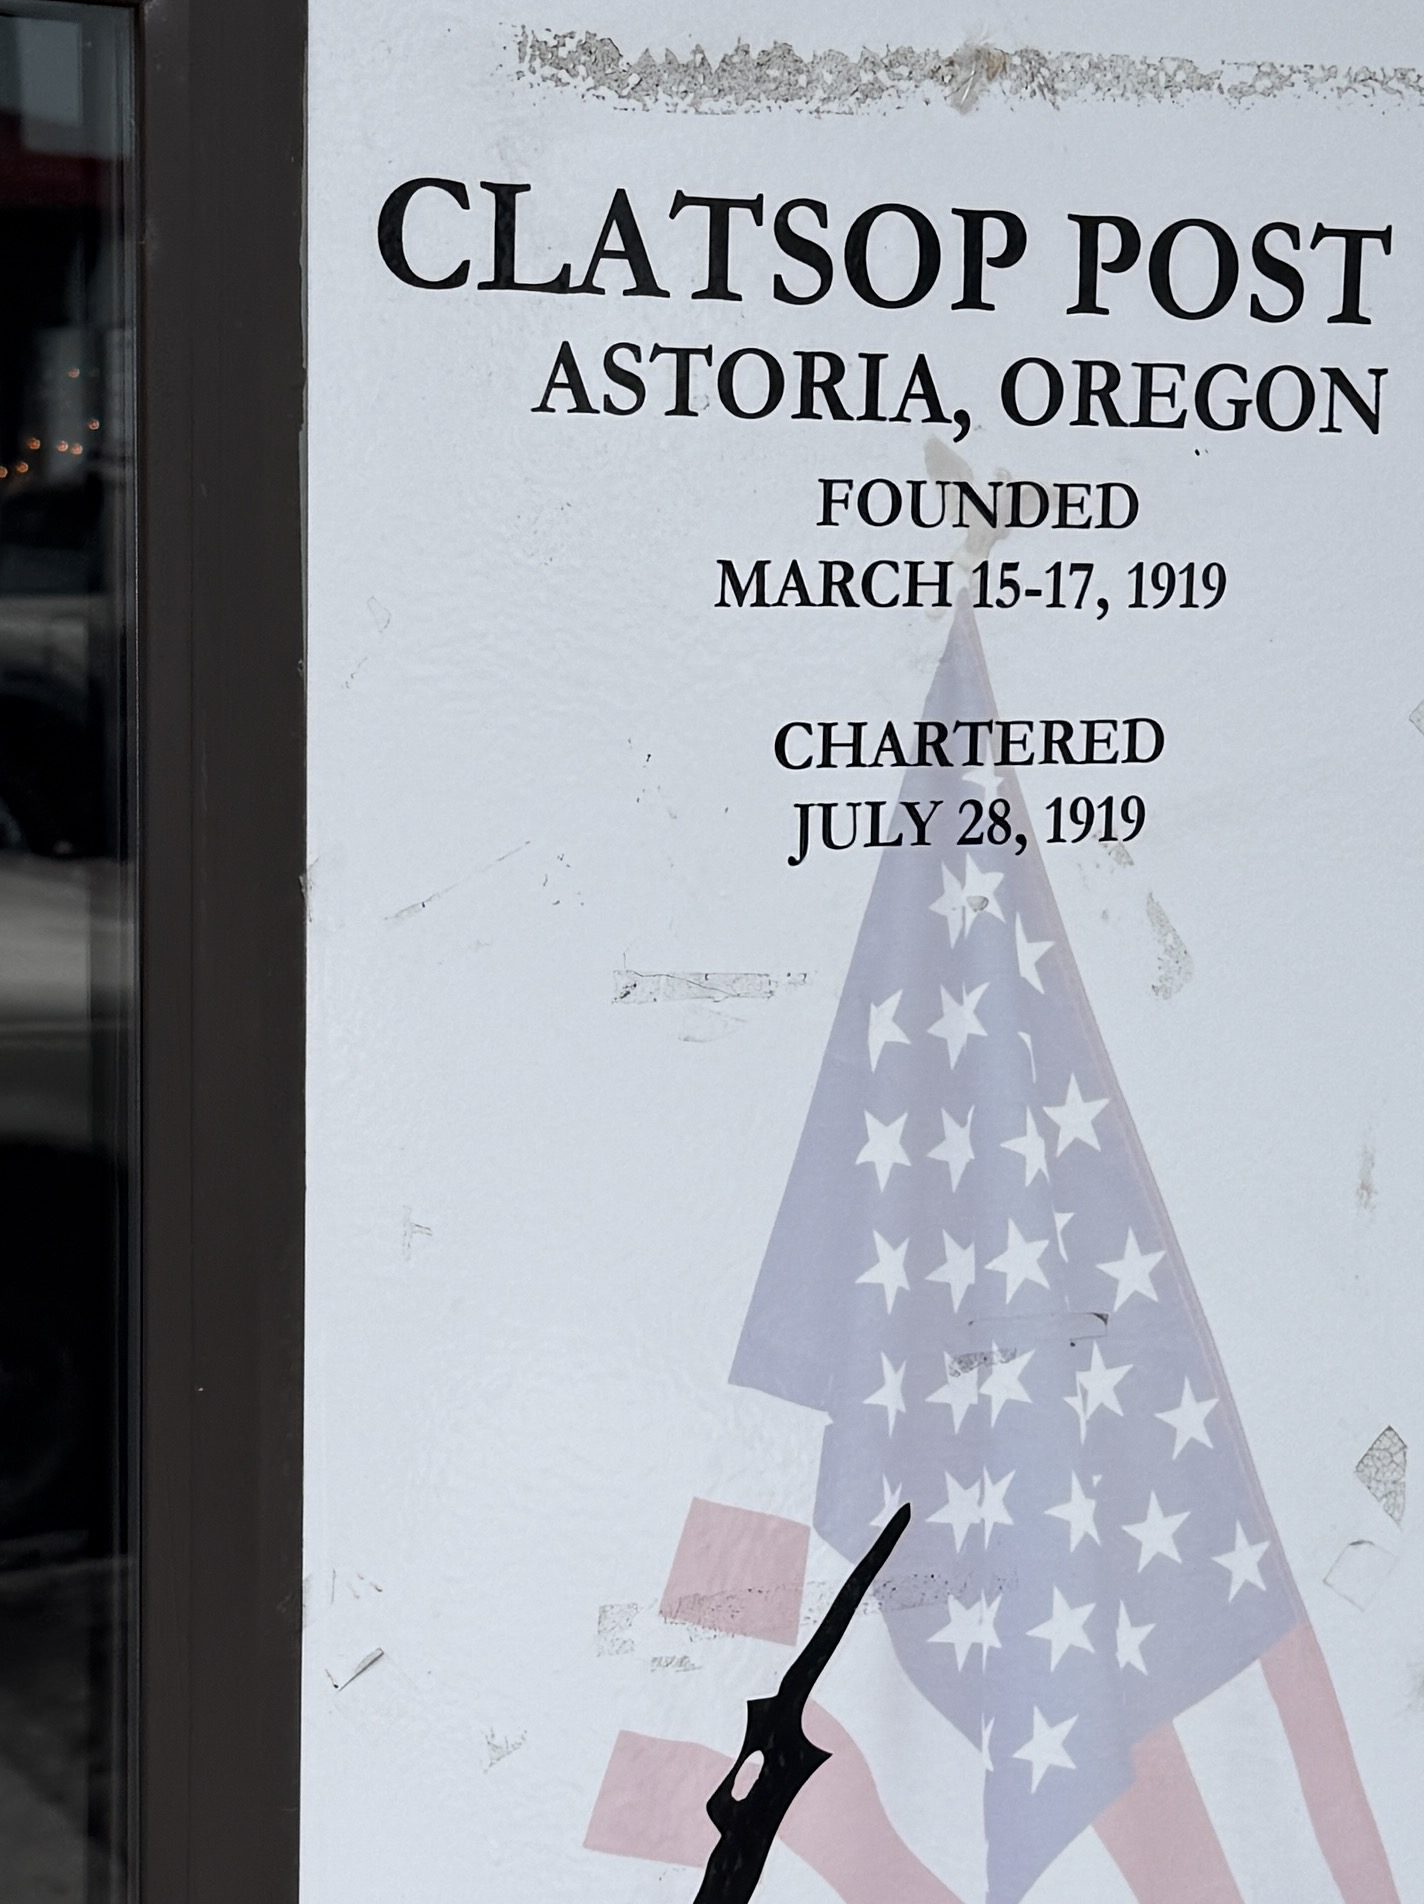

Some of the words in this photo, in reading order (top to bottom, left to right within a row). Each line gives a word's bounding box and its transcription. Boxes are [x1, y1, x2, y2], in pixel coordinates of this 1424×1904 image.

[377, 177, 1027, 311] CLATSOP
[1066, 213, 1393, 325] POST
[530, 340, 971, 443] ASTORIA,
[1000, 357, 1389, 435] OREGON
[816, 478, 1139, 530] FOUNDED
[714, 559, 954, 610] MARCH
[972, 560, 1109, 621] 15-17,
[1128, 561, 1227, 610] 1919
[774, 717, 1165, 770] CHARTERED
[787, 800, 944, 867] JULY
[956, 798, 1028, 856] 28,
[1045, 795, 1146, 846] 1919
